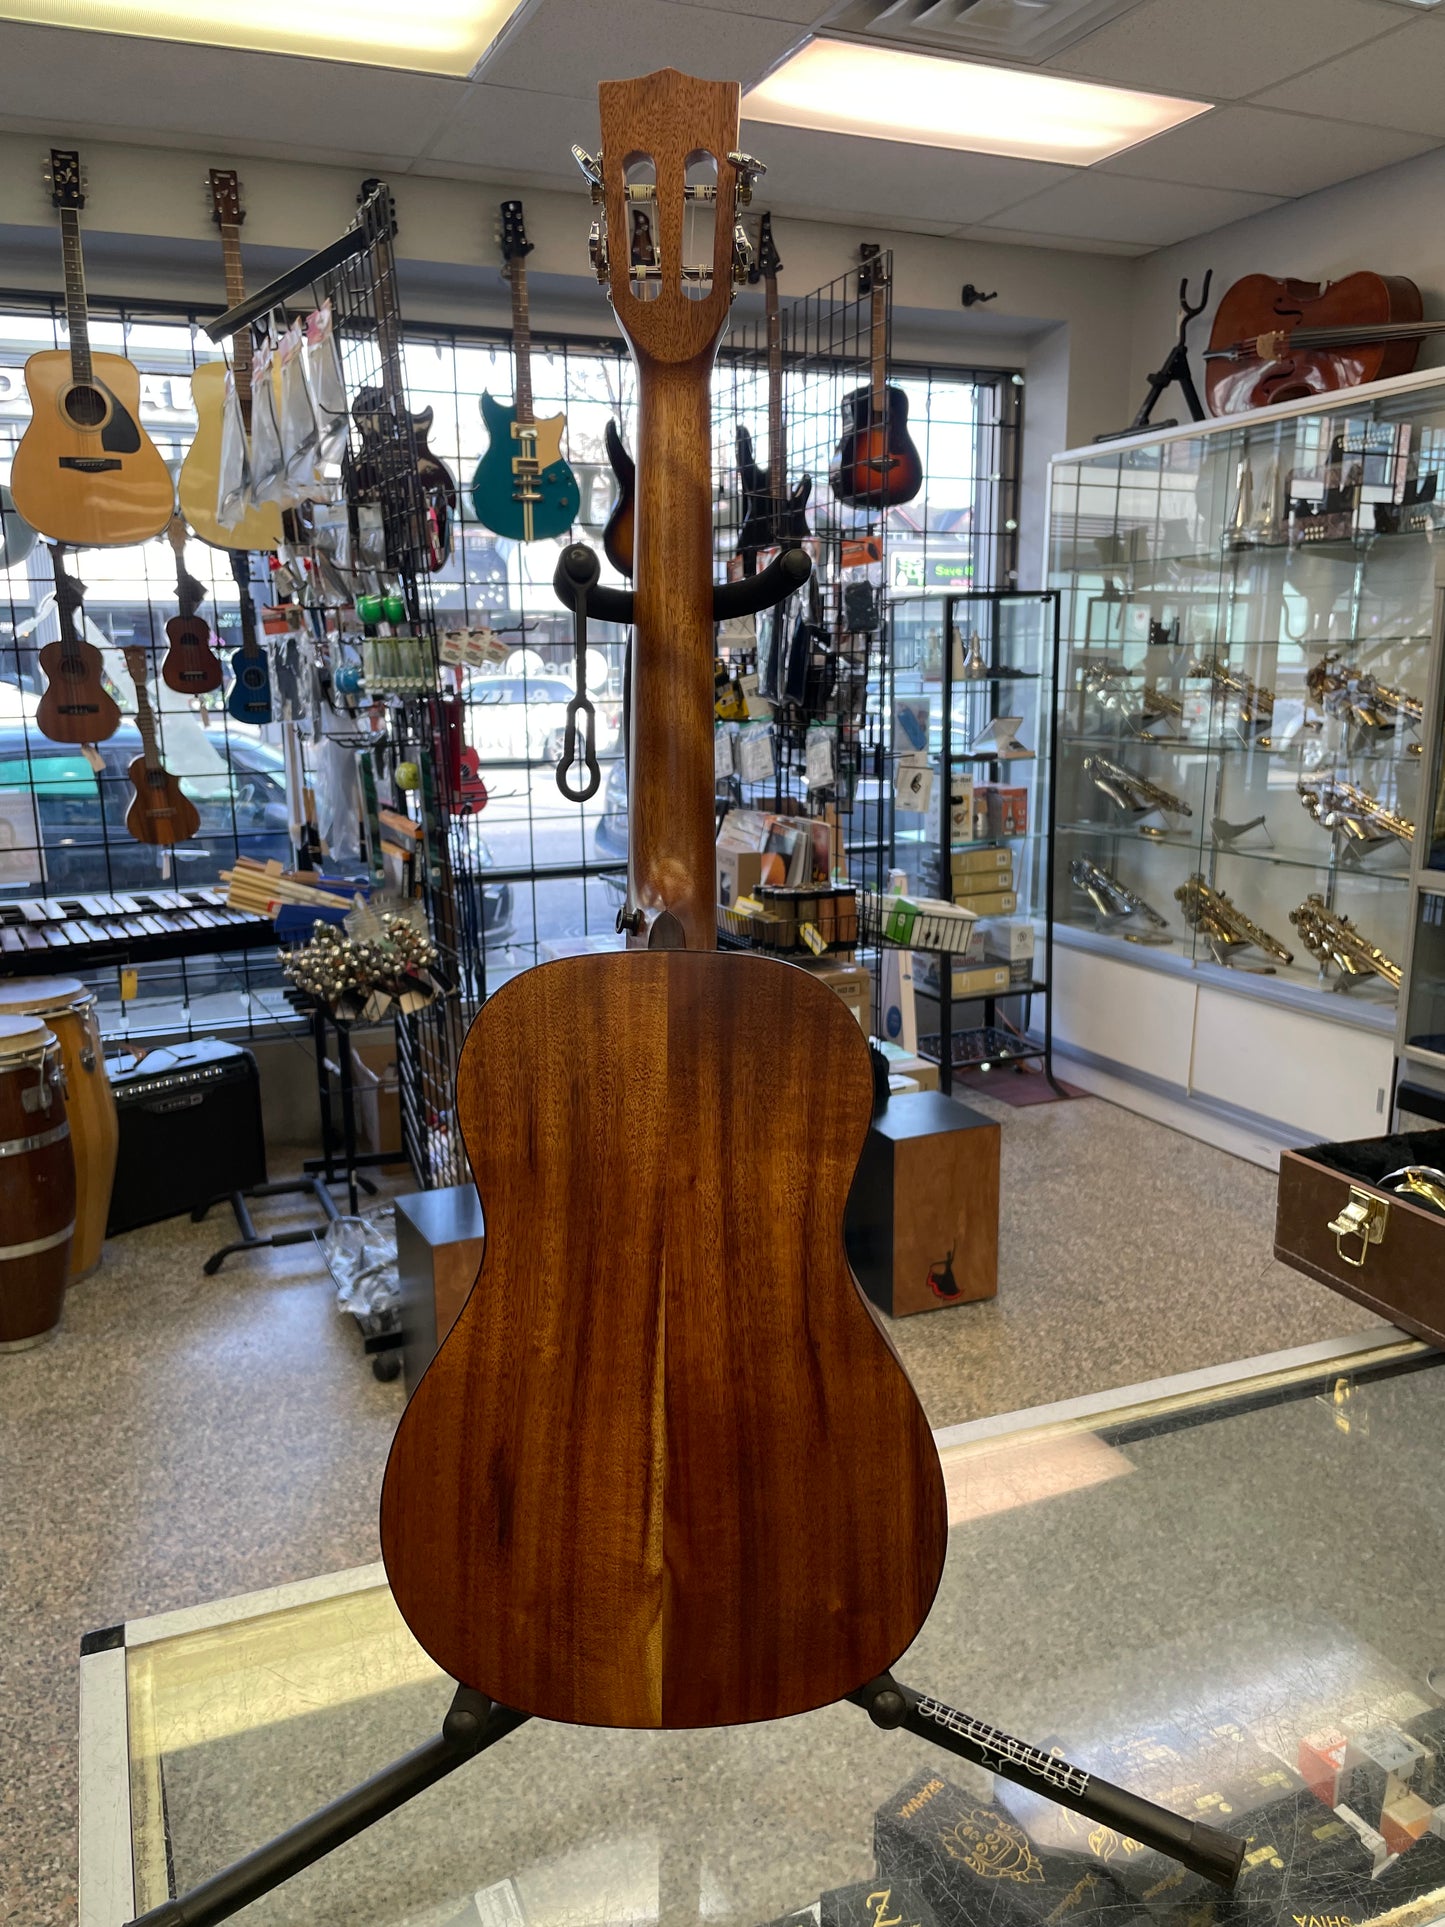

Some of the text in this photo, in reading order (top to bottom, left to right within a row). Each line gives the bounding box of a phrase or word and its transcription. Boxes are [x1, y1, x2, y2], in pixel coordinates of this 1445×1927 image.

[917, 1697, 1090, 1796] STRUKTURE
[897, 1779, 945, 1819] BRAHMA
[1292, 1914, 1351, 1927] SHIVA
